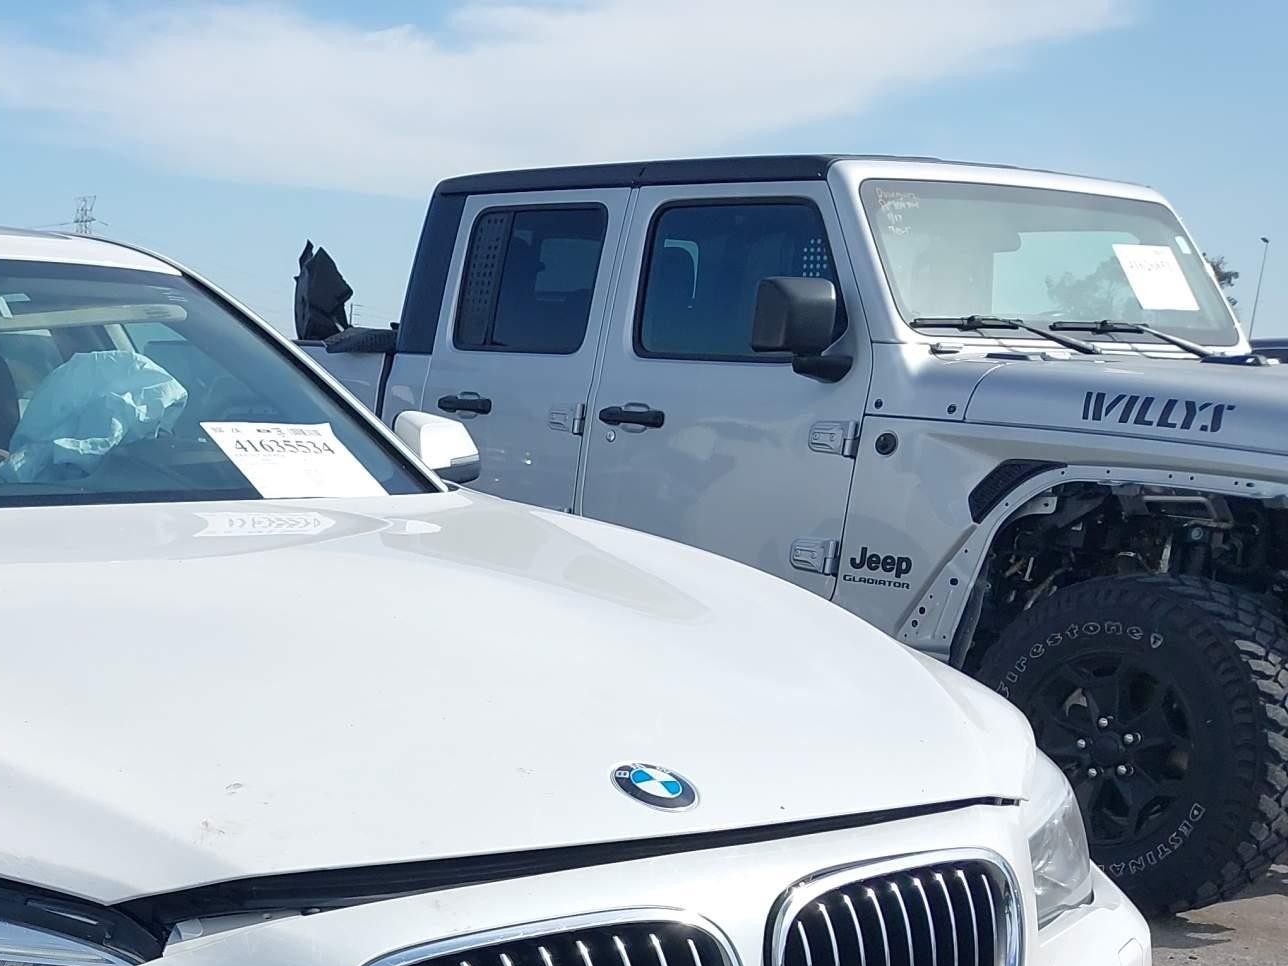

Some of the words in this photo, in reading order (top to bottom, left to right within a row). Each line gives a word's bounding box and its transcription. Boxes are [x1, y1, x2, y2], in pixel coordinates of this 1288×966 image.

[1082, 391, 1236, 433] WILLYS
[234, 438, 335, 455] 41635534
[850, 546, 912, 579] Jeep
[843, 574, 911, 590] GLADIATOR
